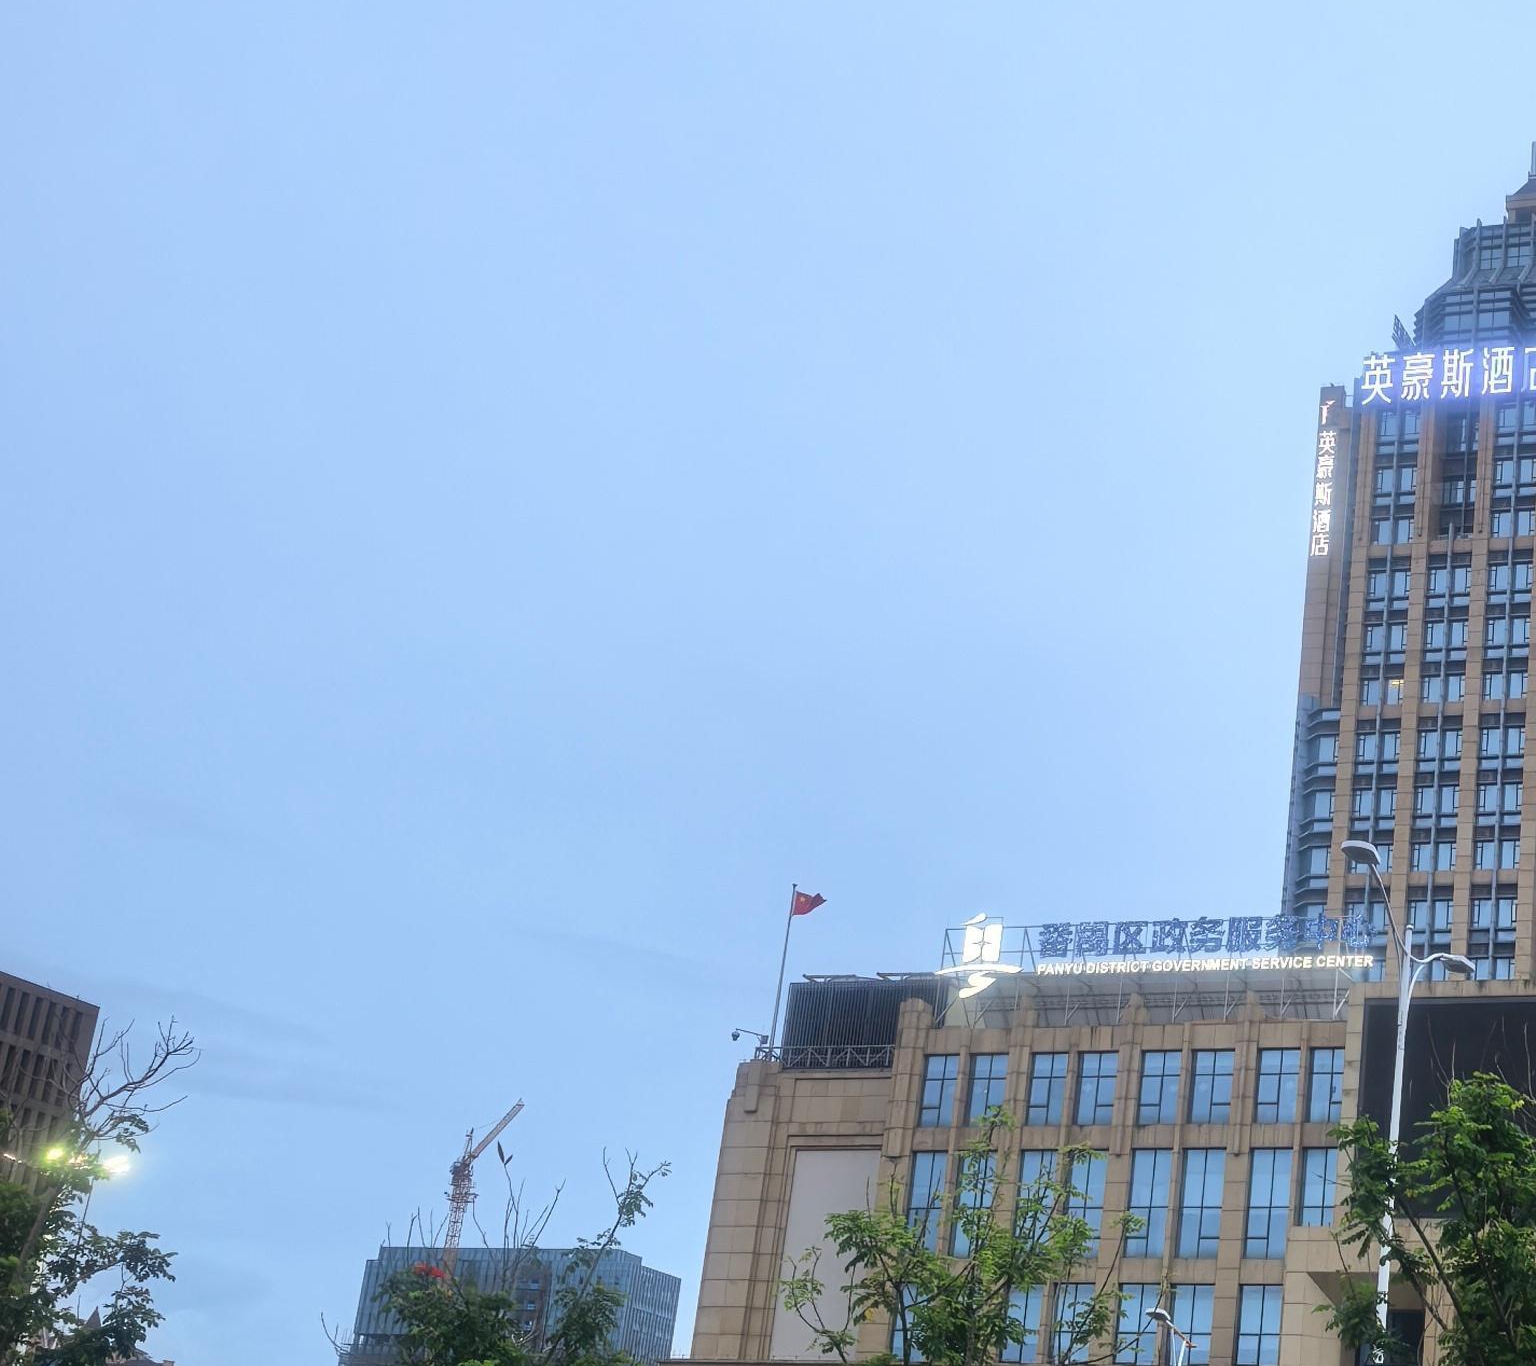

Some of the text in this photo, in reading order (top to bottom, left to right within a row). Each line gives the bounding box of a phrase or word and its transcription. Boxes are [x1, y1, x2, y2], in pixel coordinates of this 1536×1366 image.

[1310, 430, 1337, 557] 英豪斯酒店
[1038, 913, 1376, 959] 番禺区政务服务中心
[1037, 954, 1374, 976] PANYU DISTRICT GOVERNMENT SERVICE CENTER
